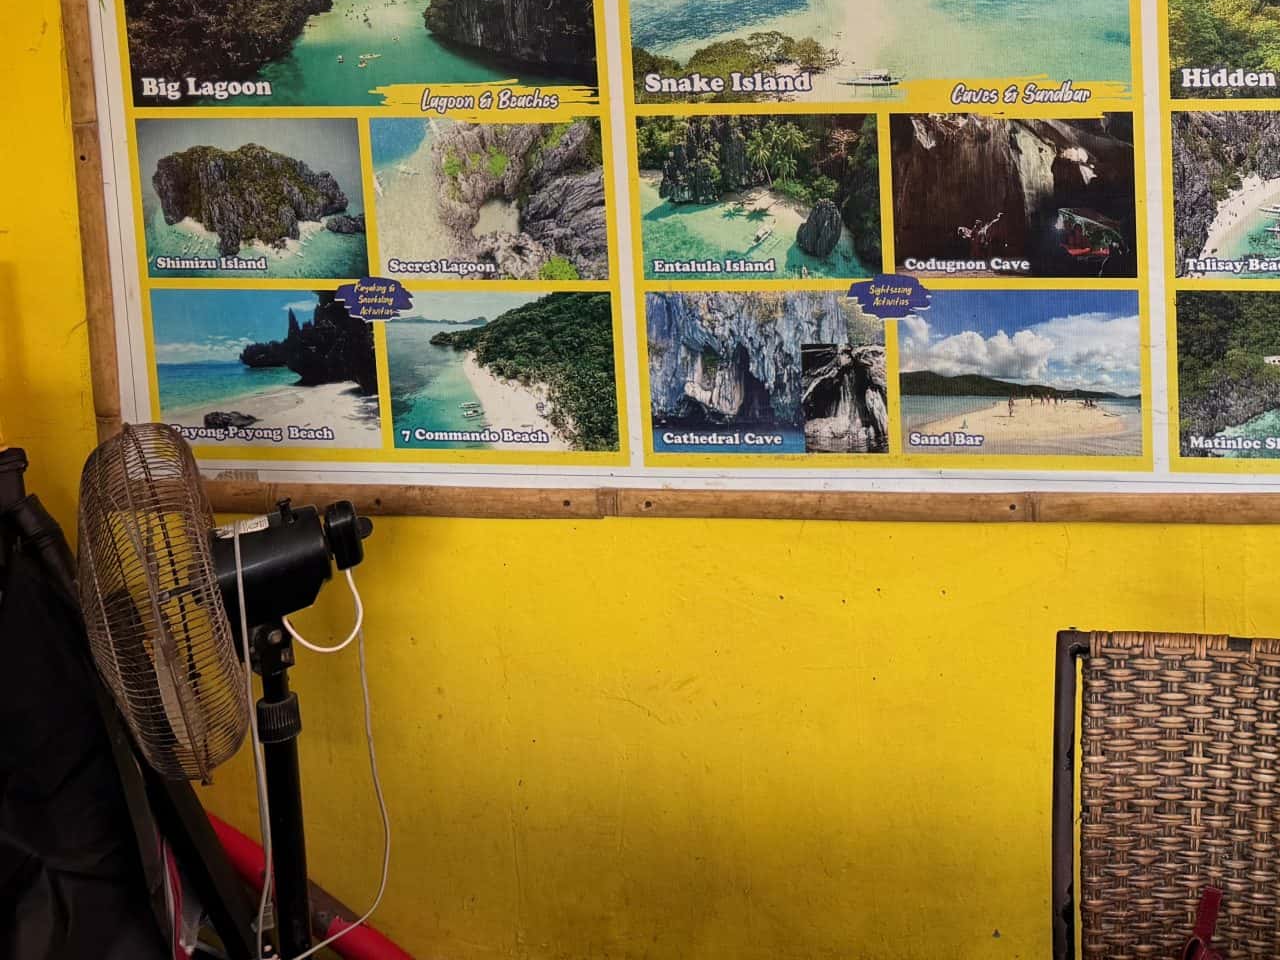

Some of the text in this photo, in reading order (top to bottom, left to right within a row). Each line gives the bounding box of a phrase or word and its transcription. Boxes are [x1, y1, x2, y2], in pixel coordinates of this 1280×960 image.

[644, 72, 813, 94] Snake Island
[1181, 68, 1280, 89] Hidden
[141, 77, 272, 100] Big Lagoon
[951, 79, 1091, 104] Caves & Sandbar
[421, 88, 559, 114] Lagoon & Beaches
[155, 255, 268, 271] Shimizu Island
[389, 259, 496, 275] Secret Lagoon
[653, 258, 776, 274] Entalula Island
[904, 258, 1030, 273] Codugnon Cave
[1186, 258, 1243, 274] Talisay
[869, 284, 913, 296] Sightseeing
[873, 296, 910, 307] Activities
[288, 425, 334, 440] Beach
[401, 428, 549, 443] 7 Commando Beach
[662, 432, 783, 445] Cathedral Cave
[910, 432, 984, 447] Sand Bar
[1189, 436, 1261, 449] Matinloc
